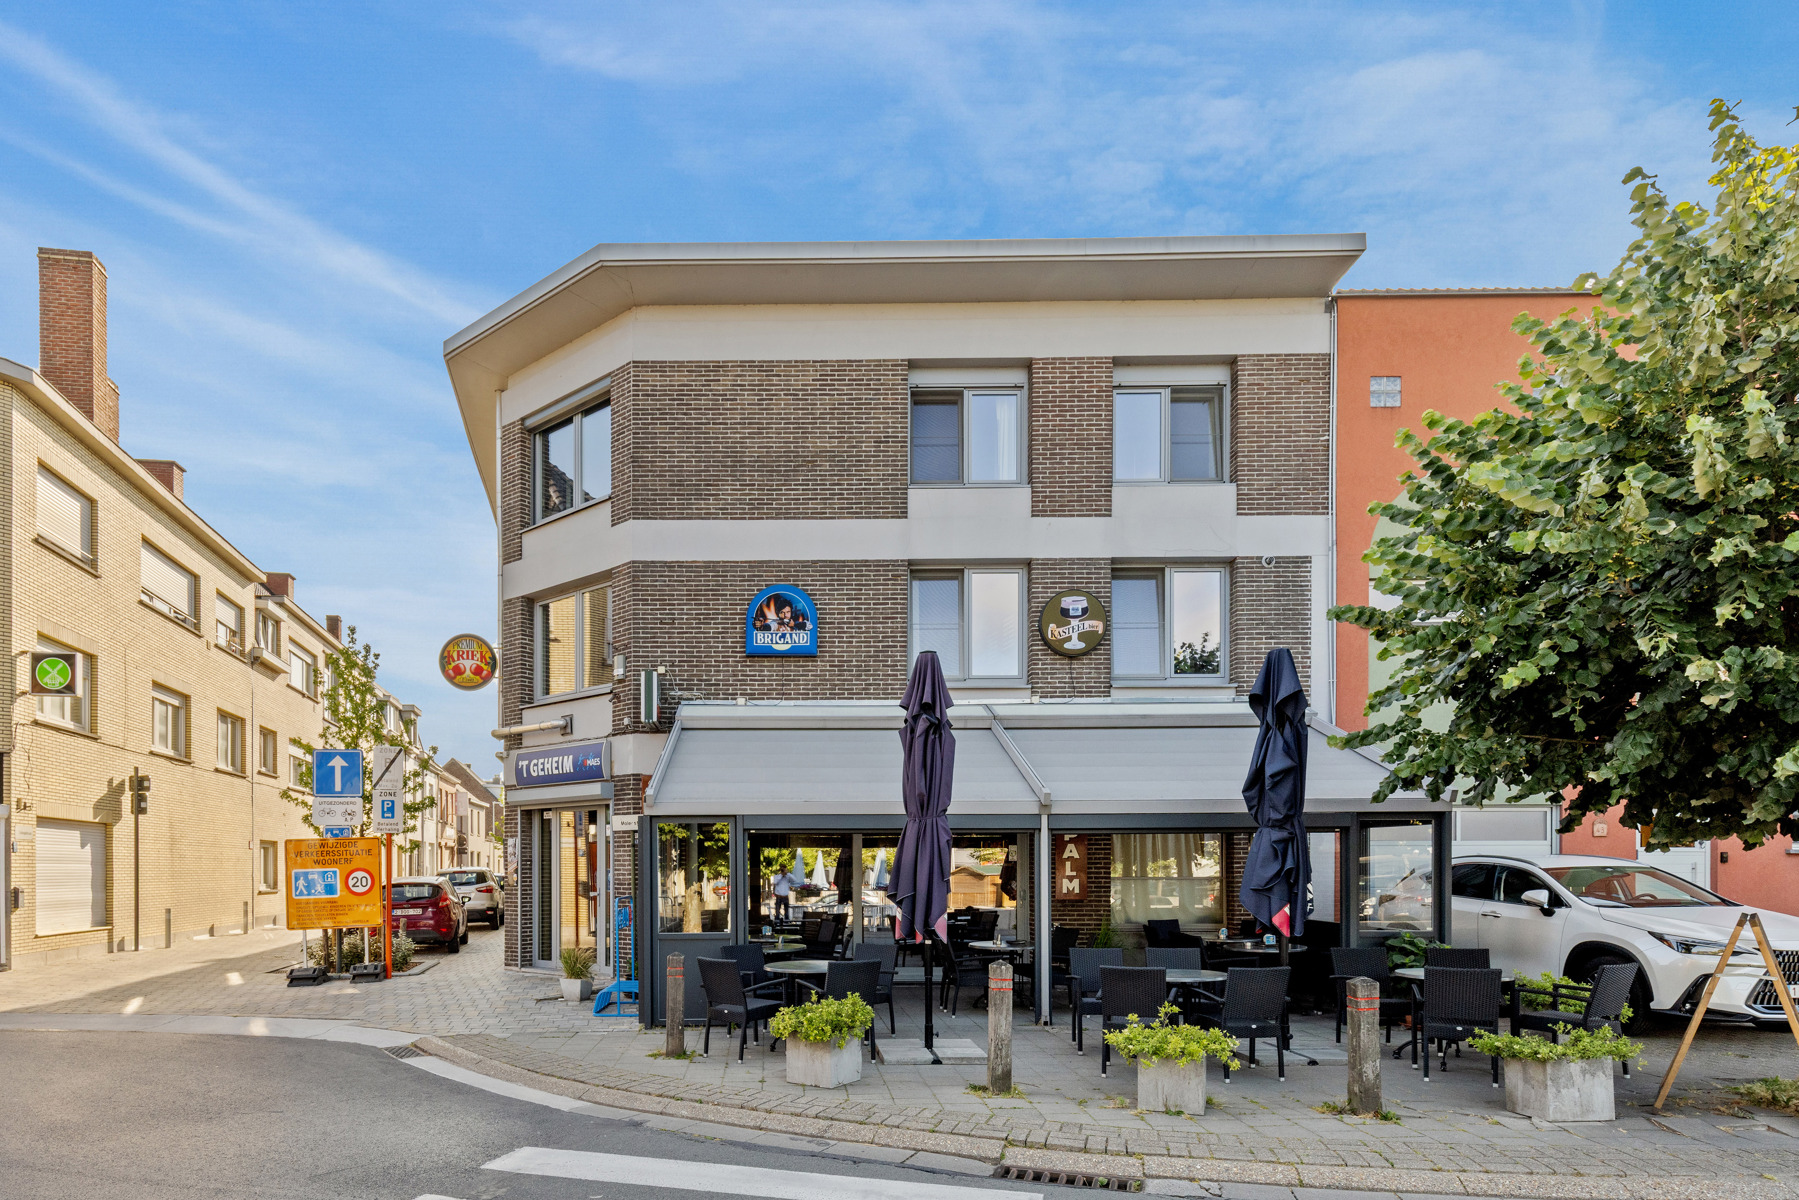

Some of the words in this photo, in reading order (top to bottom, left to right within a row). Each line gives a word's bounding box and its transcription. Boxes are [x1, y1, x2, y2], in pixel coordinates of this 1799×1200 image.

[1050, 622, 1087, 639] KASTEEL
[757, 632, 807, 644] BRIGAND
[452, 639, 483, 650] PREMIUM
[446, 650, 489, 666] KRIEK
[518, 760, 529, 778] 'T
[530, 755, 574, 777] GEHEIM
[586, 758, 601, 766] MAES
[384, 801, 392, 811] P
[307, 841, 359, 850] GEWIJZIGDE
[294, 849, 373, 858] VERKEERSSITUATIE
[313, 858, 354, 866] WOONERF
[351, 876, 369, 888] 20
